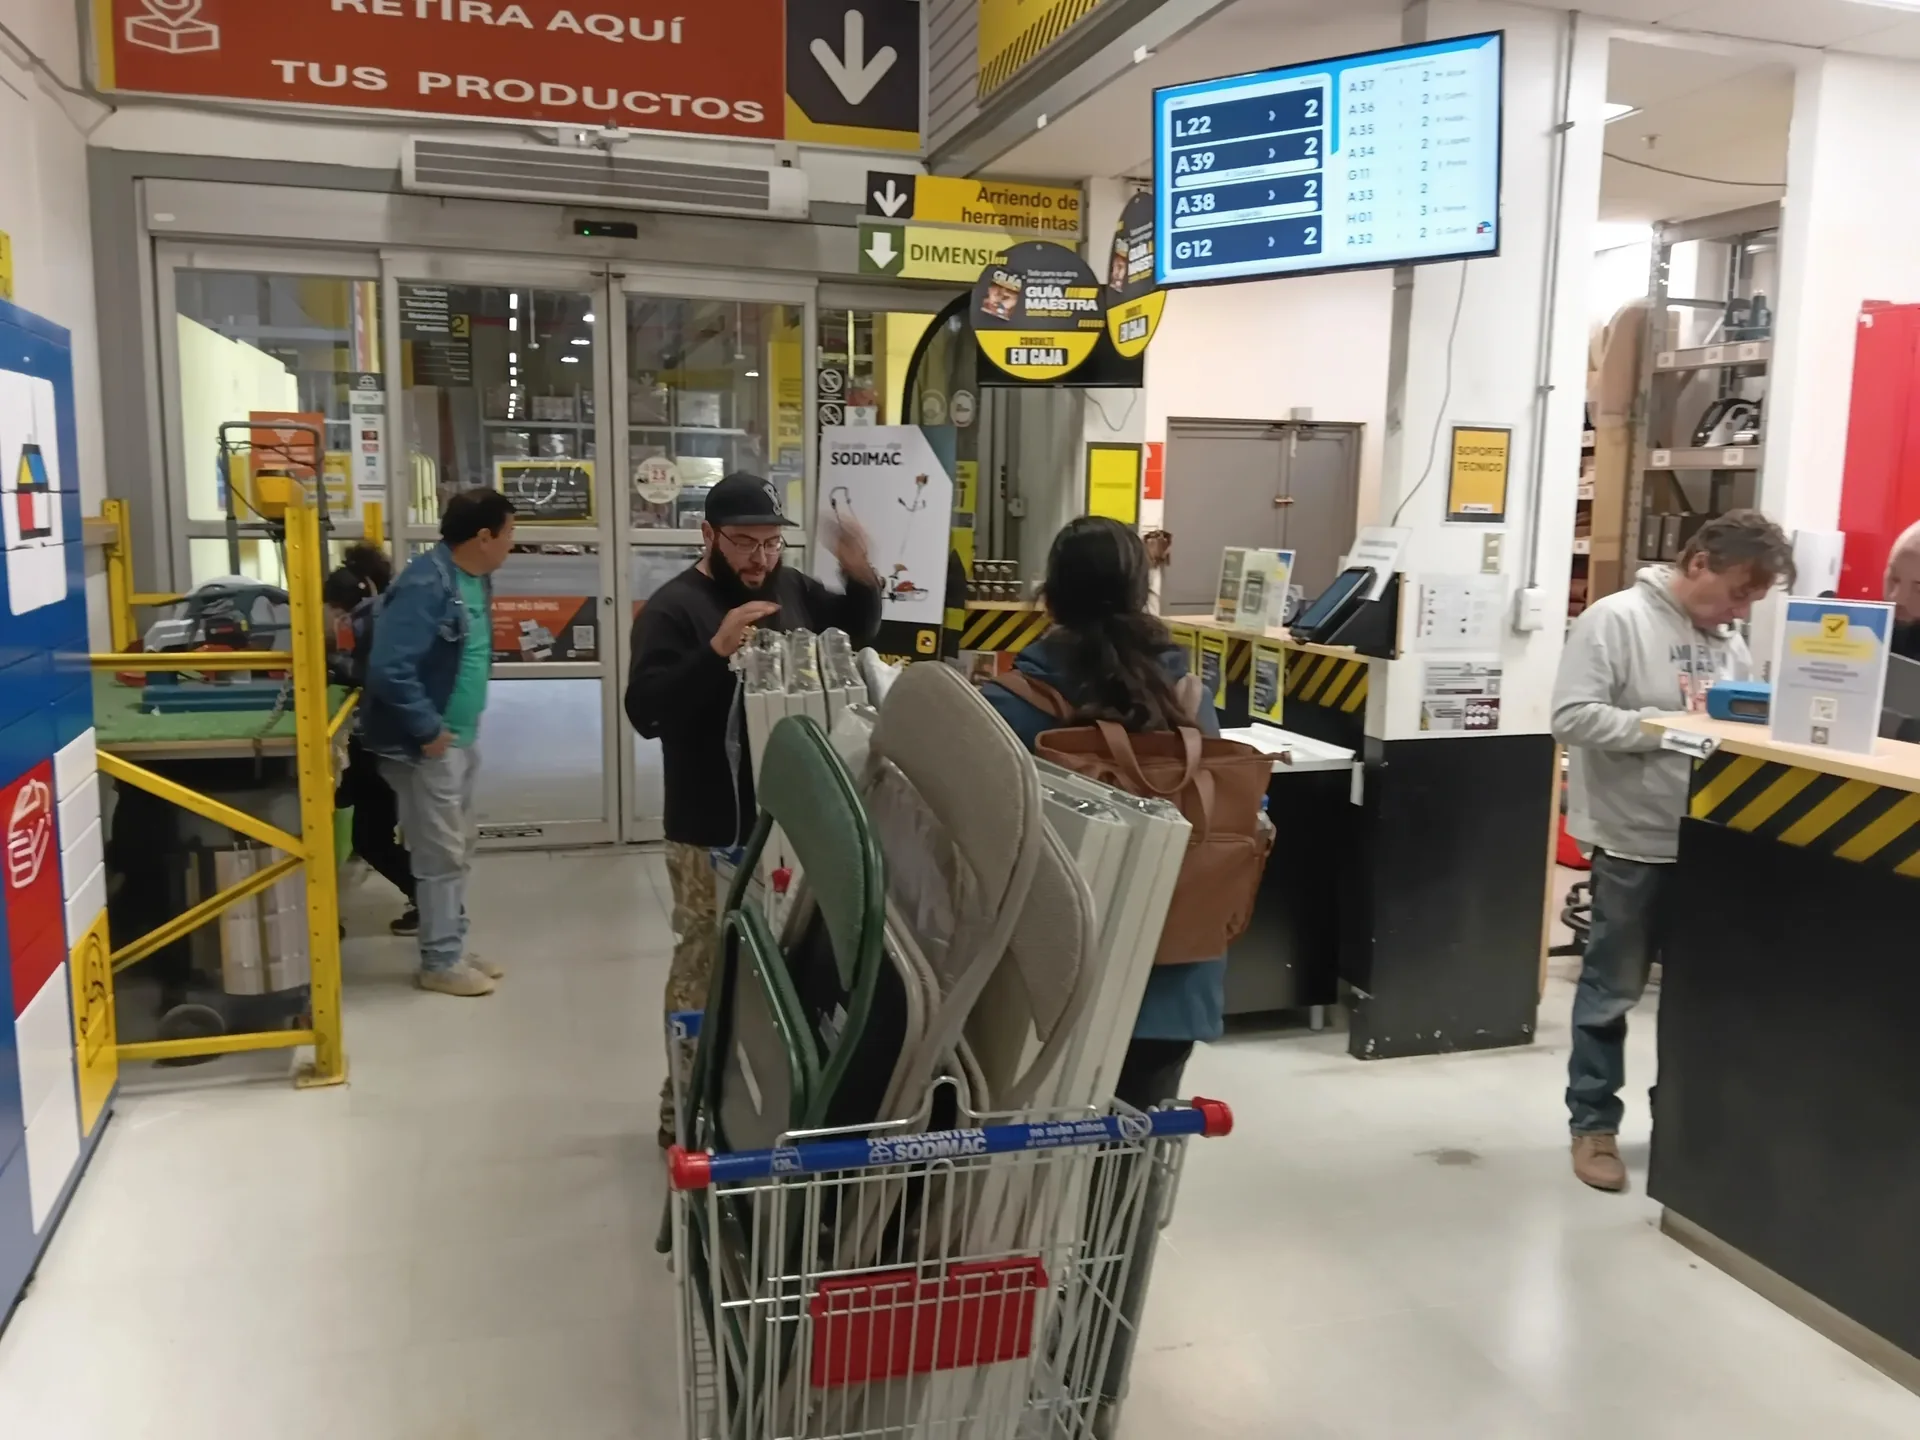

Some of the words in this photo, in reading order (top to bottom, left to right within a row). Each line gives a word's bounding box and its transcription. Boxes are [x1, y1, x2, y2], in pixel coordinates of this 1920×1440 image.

[546, 10, 686, 45] AQUÍ
[1422, 70, 1430, 82] 2
[271, 60, 388, 91] TUS
[418, 71, 765, 123] PRODUCTOS
[1422, 93, 1430, 105] 2
[1175, 116, 1212, 138] L22
[1304, 99, 1319, 118] 2
[1421, 116, 1429, 127] 2
[1421, 138, 1429, 149] 2
[1175, 152, 1215, 174] A39
[1304, 137, 1318, 156] 2
[1421, 160, 1428, 172] 2
[1420, 183, 1428, 194] 2
[976, 186, 1052, 209] Arriendo
[1057, 195, 1079, 211] de
[1175, 193, 1215, 215] A38
[1304, 179, 1318, 198] 2
[1420, 205, 1427, 216] 3
[962, 206, 1078, 231] herramientas
[1420, 227, 1427, 238] 2
[1175, 239, 1213, 260] G12
[1303, 227, 1317, 245] 2
[1025, 285, 1063, 298] GUÍA
[1025, 299, 1098, 311] MAESTRA
[452, 316, 464, 333] 2
[1010, 349, 1028, 364] EN
[1030, 349, 1064, 365] CAJA
[831, 451, 902, 466] SODIMAC
[1456, 445, 1505, 457] SOPORTE
[1457, 461, 1503, 472] TECNICO
[1046, 1124, 1074, 1137] suba
[1075, 1121, 1107, 1133] niños
[894, 1137, 988, 1161] SODIMAC
